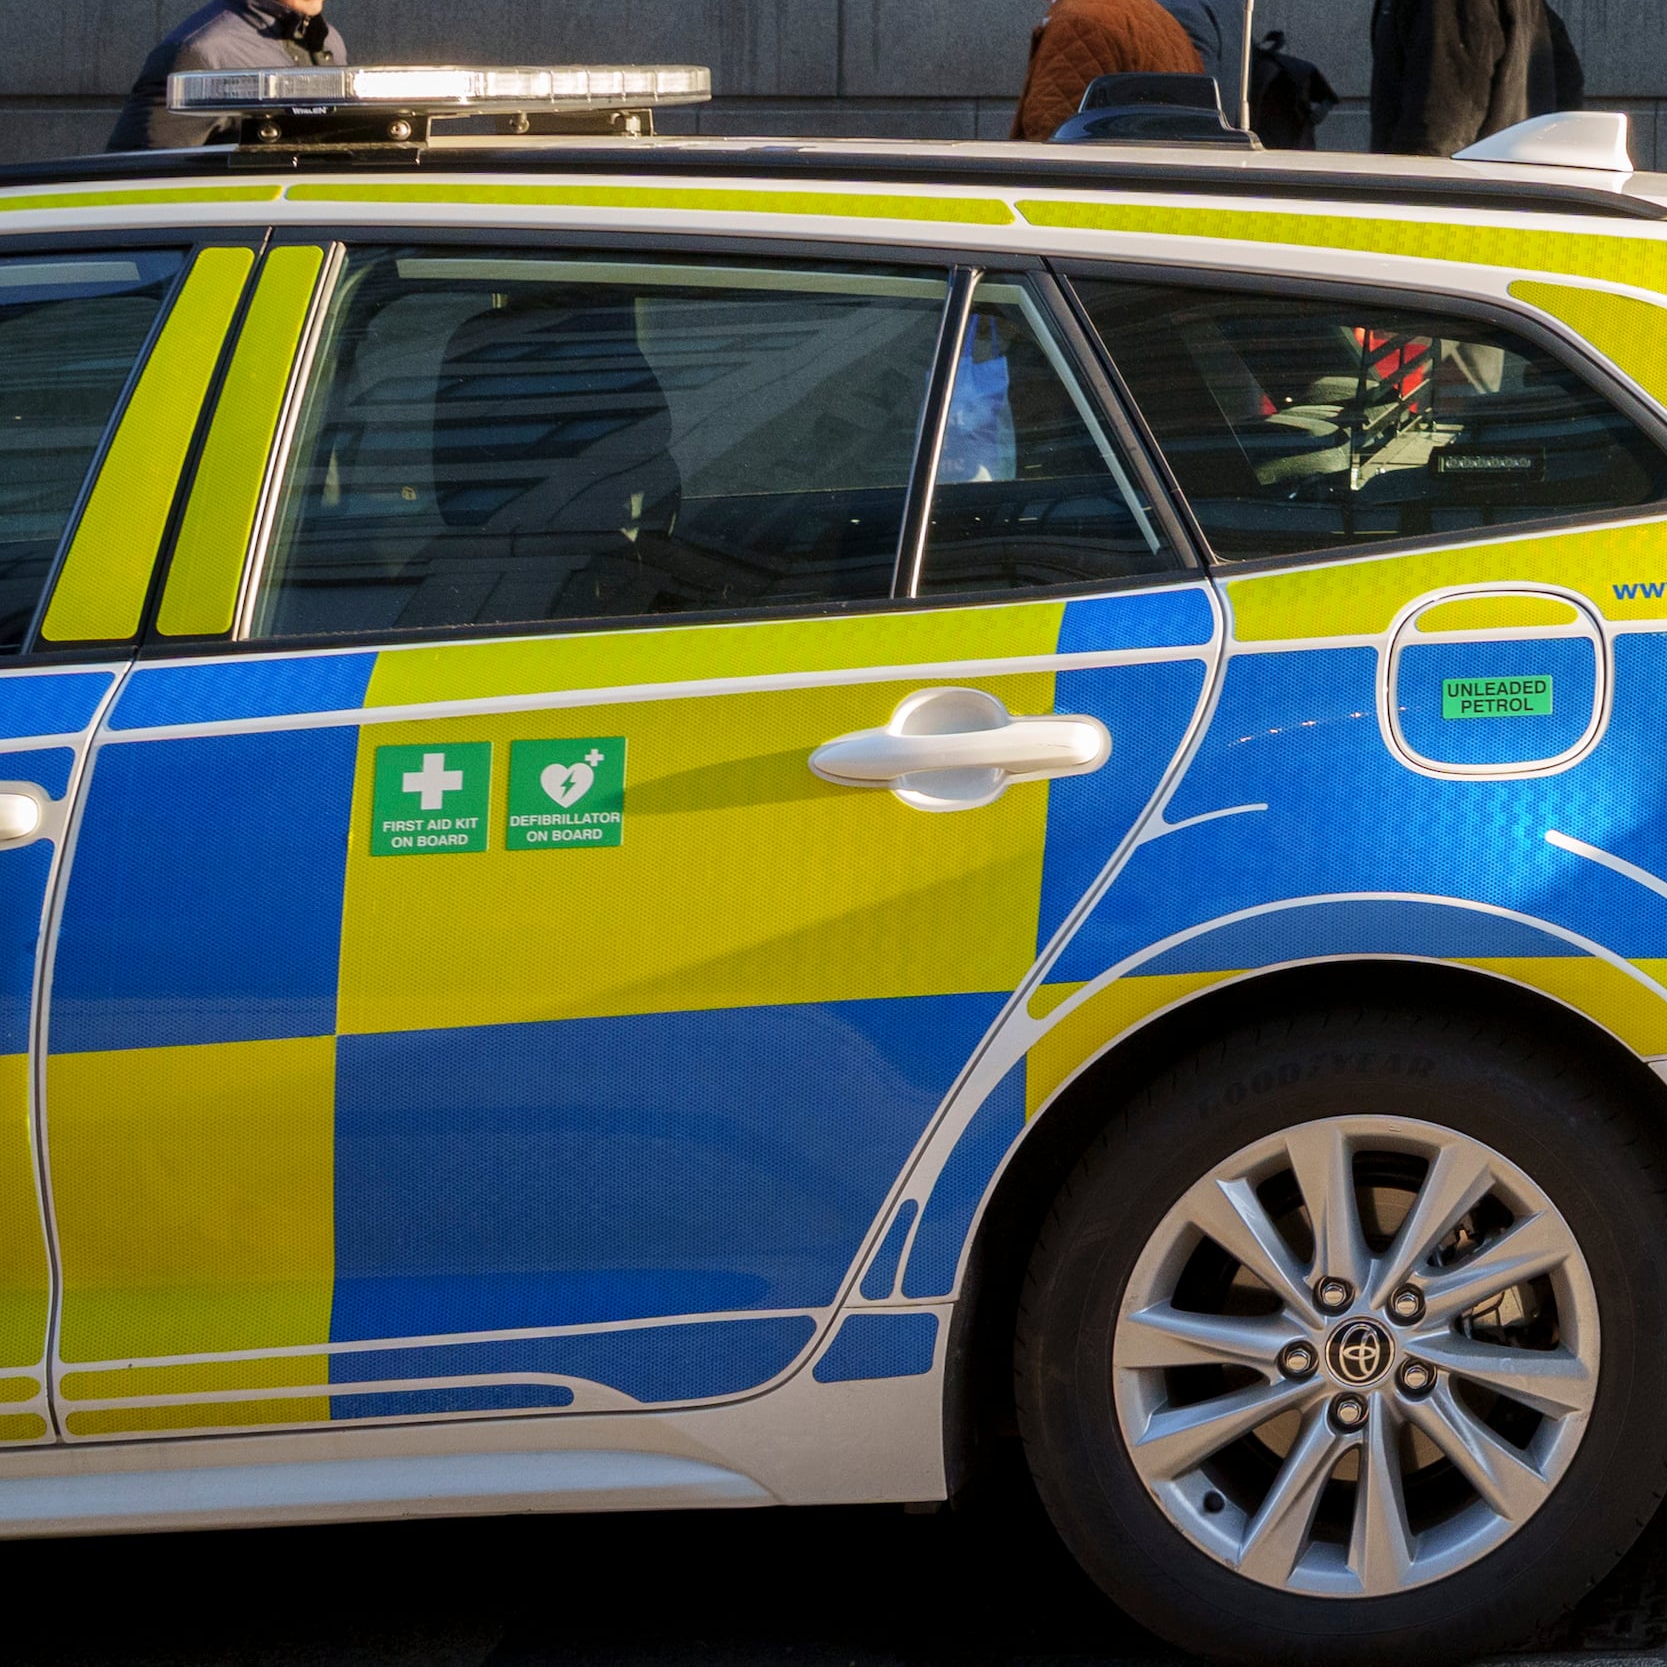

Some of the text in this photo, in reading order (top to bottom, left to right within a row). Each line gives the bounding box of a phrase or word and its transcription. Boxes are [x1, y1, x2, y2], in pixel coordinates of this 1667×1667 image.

[1447, 680, 1547, 698] UNLEADED
[1461, 697, 1534, 713] PETROL
[382, 817, 479, 833] FIRST AID KIT
[510, 812, 621, 827] DEFIBRILLATOR
[391, 834, 469, 849] ON BOARD
[526, 828, 603, 843] ON BOARD
